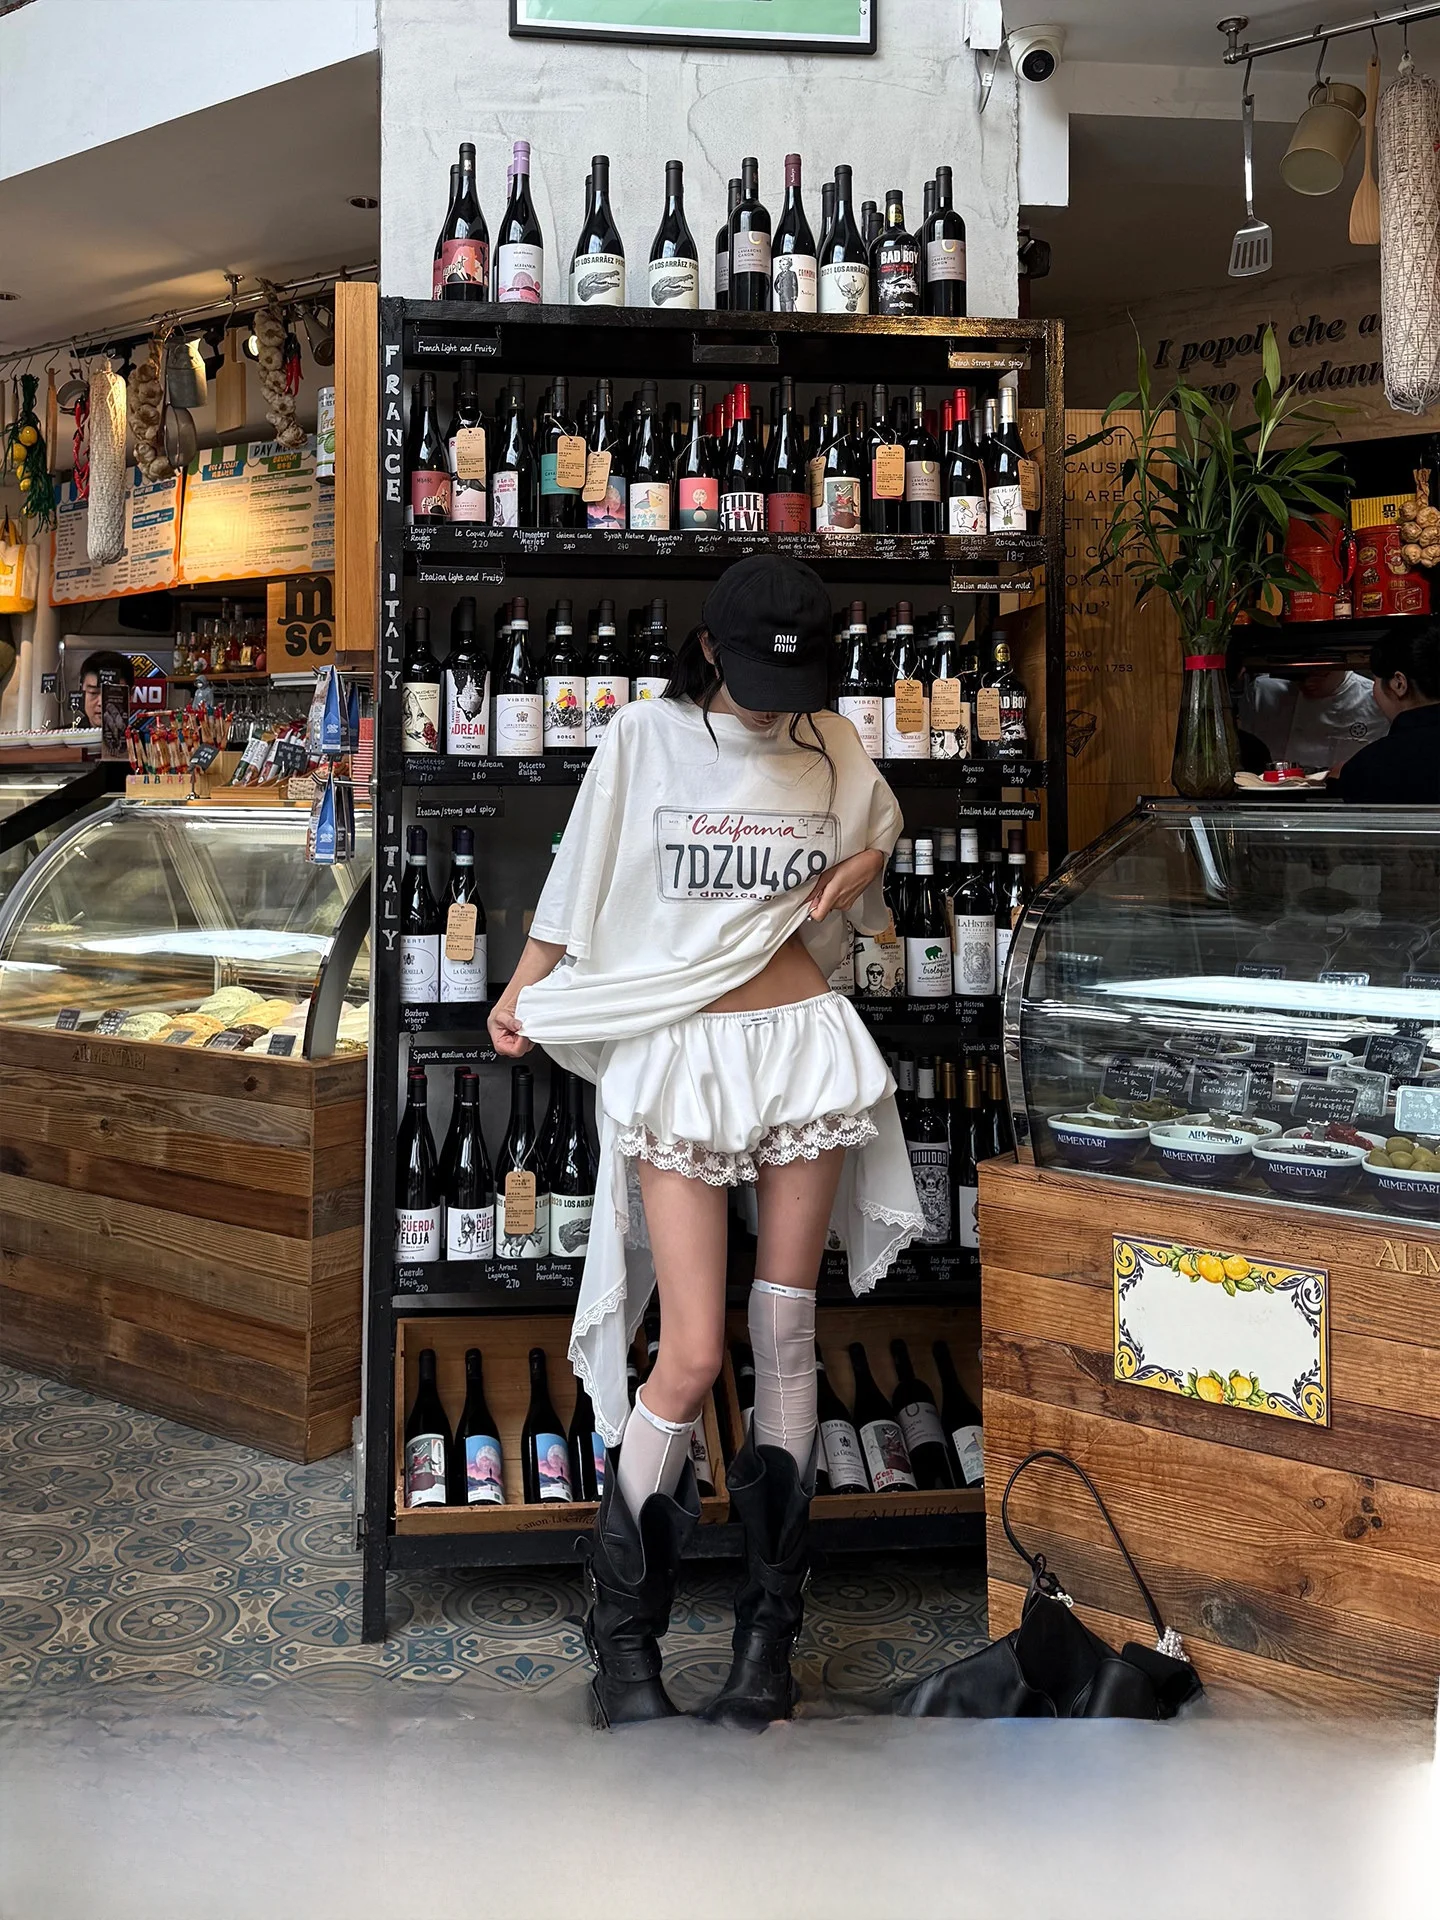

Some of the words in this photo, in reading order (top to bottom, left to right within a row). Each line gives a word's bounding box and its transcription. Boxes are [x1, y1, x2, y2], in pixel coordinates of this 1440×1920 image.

[581, 257, 591, 265] LOS
[880, 251, 901, 264] BAD
[903, 251, 919, 264] BOY
[1288, 314, 1345, 348] che
[460, 344, 472, 352] and
[384, 344, 404, 503] FRANCE
[254, 445, 272, 456] DAY
[1085, 490, 1125, 501] ARE
[455, 528, 463, 537] Le
[471, 540, 489, 549] 220
[523, 545, 539, 553] 150
[699, 545, 715, 553] 260
[420, 572, 447, 582] Italian
[465, 572, 479, 582] and
[1099, 574, 1123, 587] AT
[952, 581, 975, 590] Italian
[1000, 581, 1013, 589] and
[1015, 581, 1031, 589] mild
[384, 573, 401, 690] ITALY
[1106, 664, 1134, 673] 1753
[133, 686, 162, 703] NO
[1012, 696, 1027, 709] BOY
[454, 723, 486, 736] DREAM
[458, 760, 477, 768] Have
[518, 762, 546, 770] Dolcetto
[563, 761, 580, 773] Borga
[1002, 765, 1016, 773] Bad
[1019, 765, 1032, 777] Boy
[471, 773, 487, 781] 160
[465, 805, 477, 814] and
[480, 807, 497, 816] spicy
[959, 806, 983, 815] Italian
[983, 806, 996, 815] bold
[999, 806, 1035, 819] outstanding
[692, 814, 808, 844] California
[384, 814, 400, 951] ITALY
[404, 1009, 429, 1017] Barbera
[413, 1050, 439, 1063] Spanish
[466, 1050, 478, 1058] and
[480, 1050, 497, 1061] spicy
[1057, 1134, 1106, 1148] ALIMENTARI
[1162, 1149, 1216, 1163] ALIMENTARI
[1268, 1163, 1327, 1178] ALIMENTARI
[1378, 1178, 1440, 1194] ALIMENTARI
[401, 1220, 435, 1232] CUERDA
[401, 1233, 429, 1244] FLOJA
[485, 1264, 495, 1273] Los
[536, 1263, 547, 1271] Los
[400, 1278, 417, 1288] Floja
[416, 1284, 428, 1293] 220
[505, 1279, 520, 1289] 270
